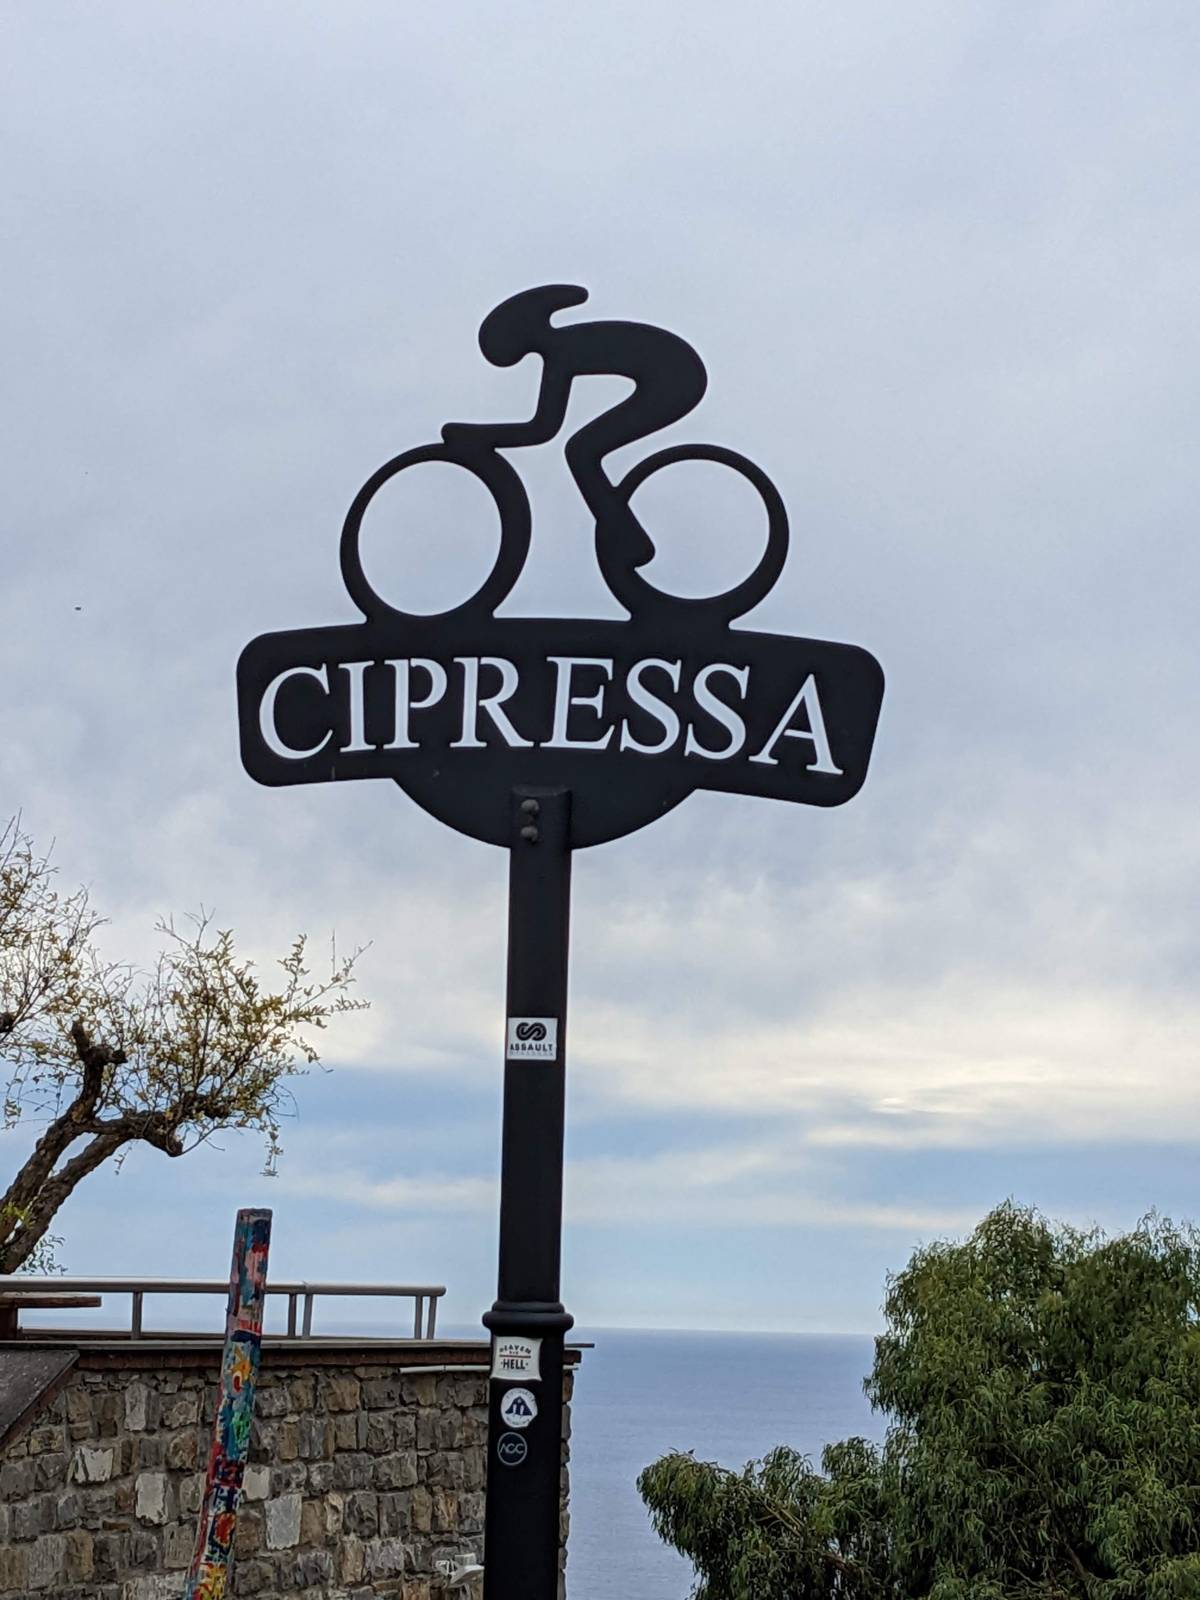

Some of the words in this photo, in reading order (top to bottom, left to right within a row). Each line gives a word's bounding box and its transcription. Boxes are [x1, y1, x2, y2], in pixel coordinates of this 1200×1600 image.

[259, 656, 843, 775] CIPRESSA
[510, 1043, 553, 1051] ASSAULT
[503, 1358, 526, 1370] HELL
